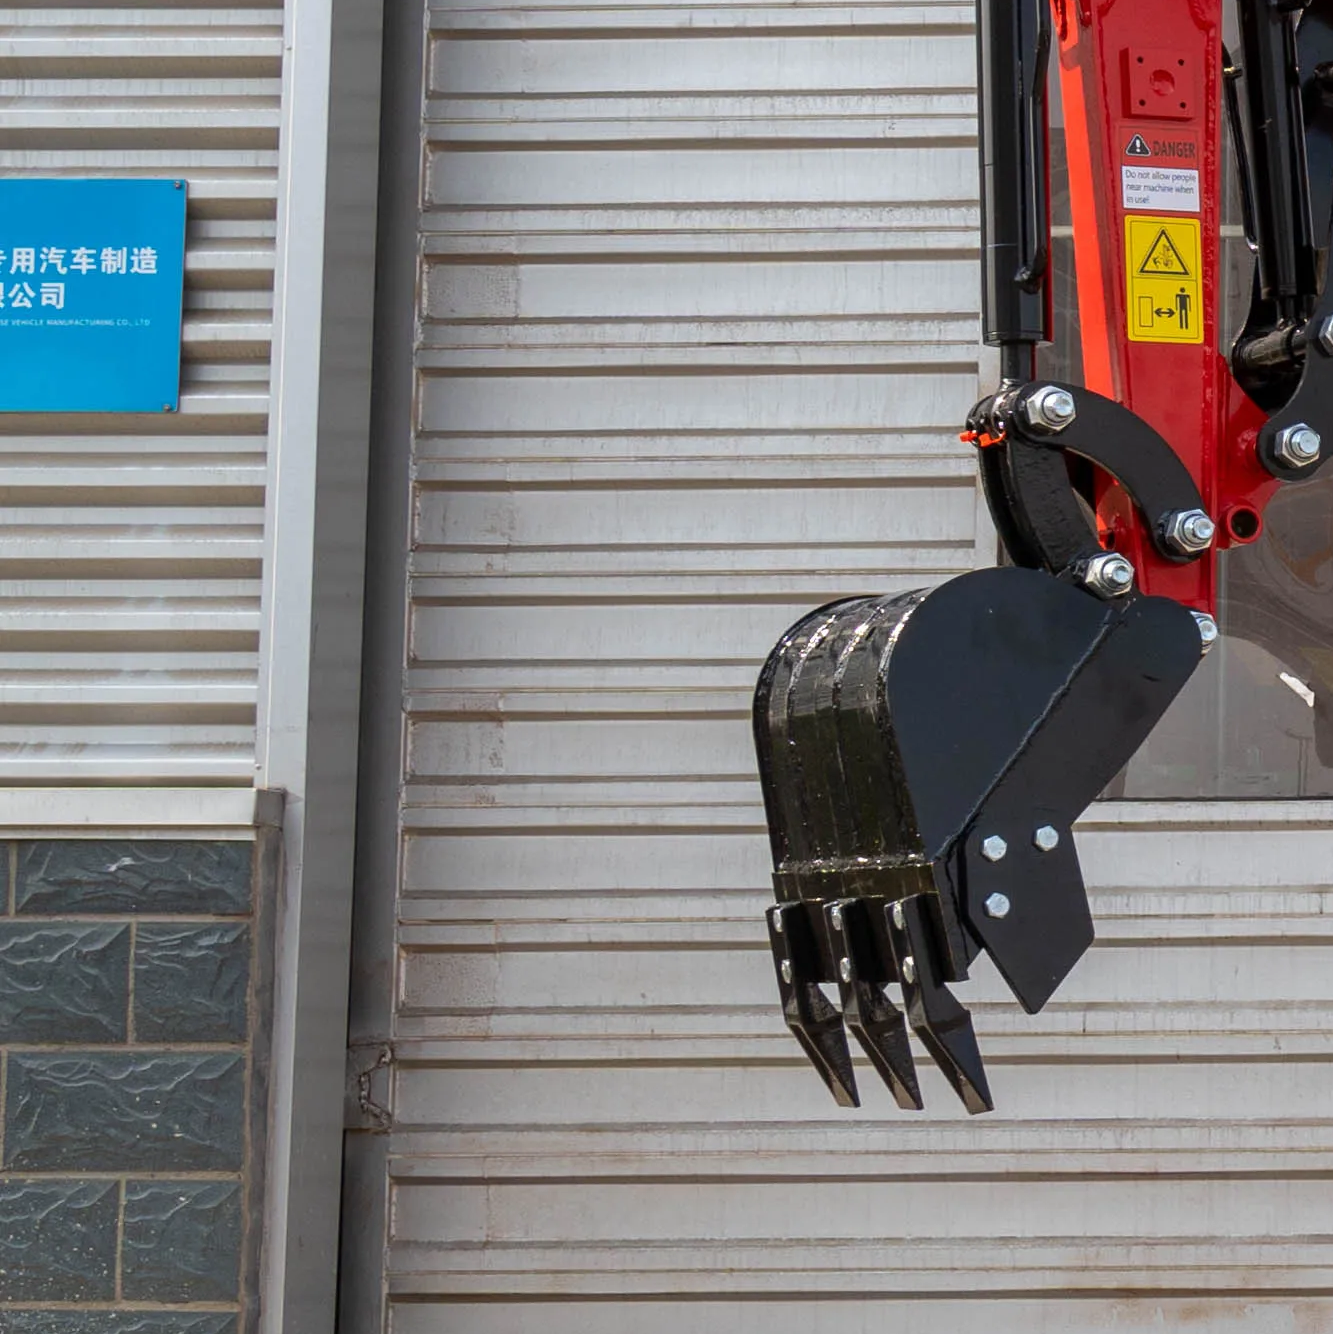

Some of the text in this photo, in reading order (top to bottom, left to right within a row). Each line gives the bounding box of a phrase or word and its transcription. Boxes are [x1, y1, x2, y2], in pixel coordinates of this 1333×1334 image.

[1153, 140, 1196, 159] DANGER
[1125, 169, 1197, 183] Do not allow people
[1143, 184, 1174, 193] machine
[1175, 185, 1195, 194] when
[0, 246, 158, 275] 用汽车制造
[0, 282, 65, 309] 公司
